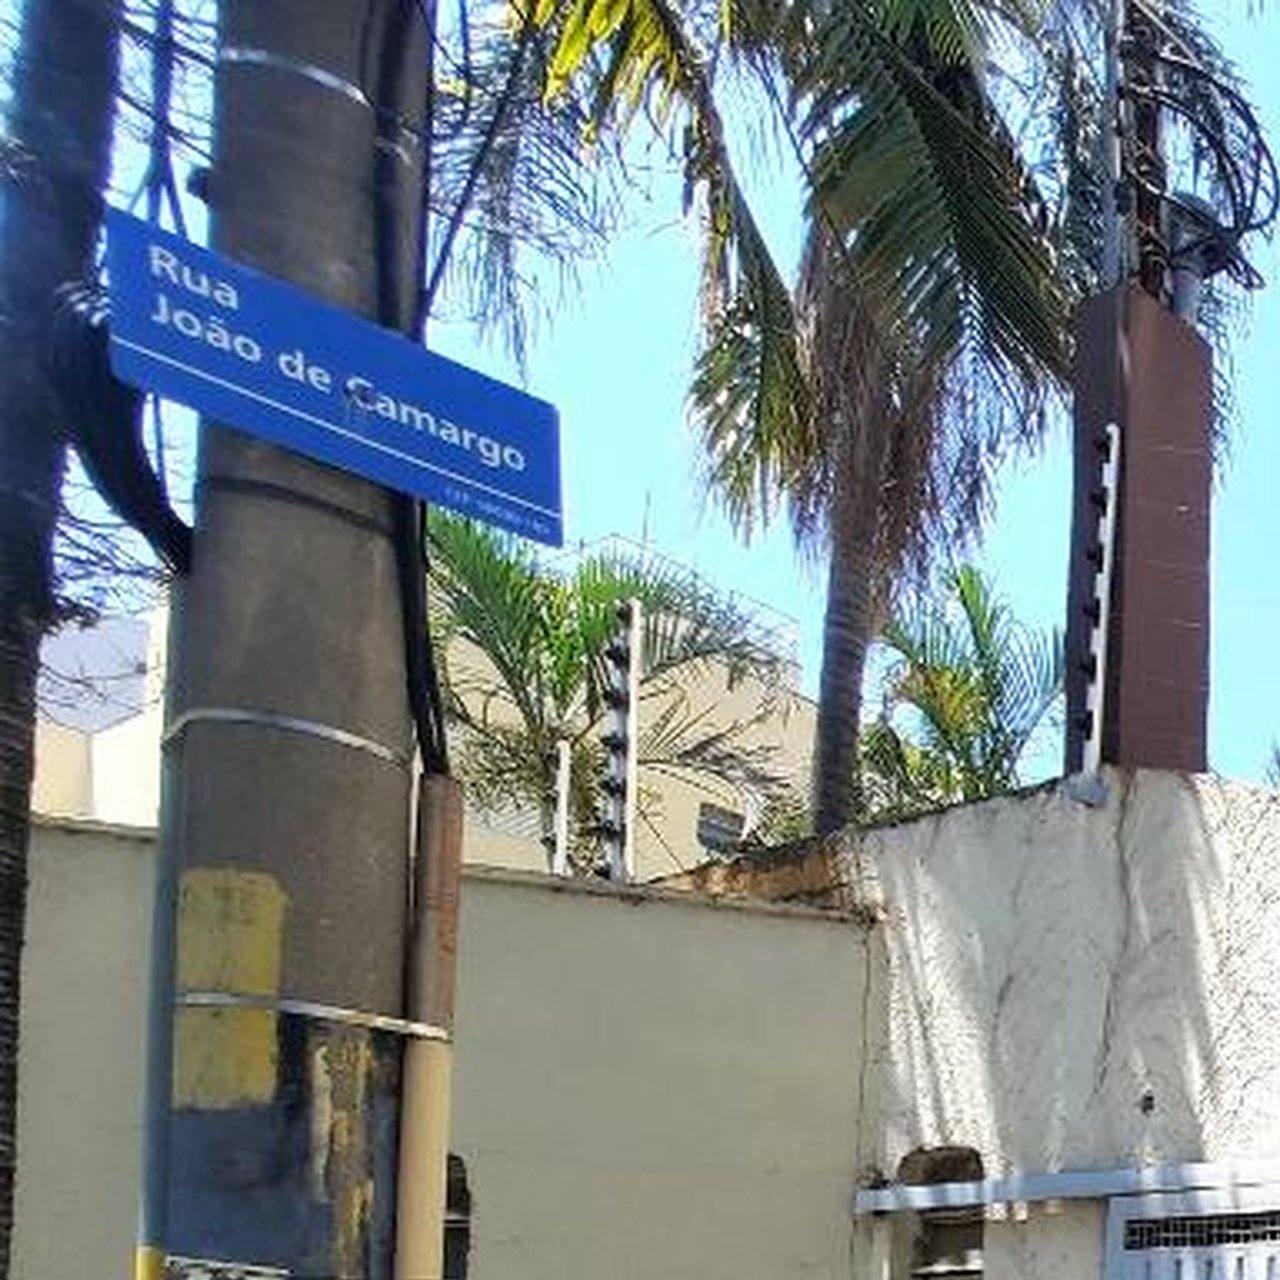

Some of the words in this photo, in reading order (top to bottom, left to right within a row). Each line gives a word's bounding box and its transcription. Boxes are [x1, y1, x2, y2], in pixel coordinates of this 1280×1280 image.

[148, 245, 240, 311] Rua
[150, 293, 263, 363] João
[278, 350, 332, 394] de
[345, 375, 527, 472] Camargo
